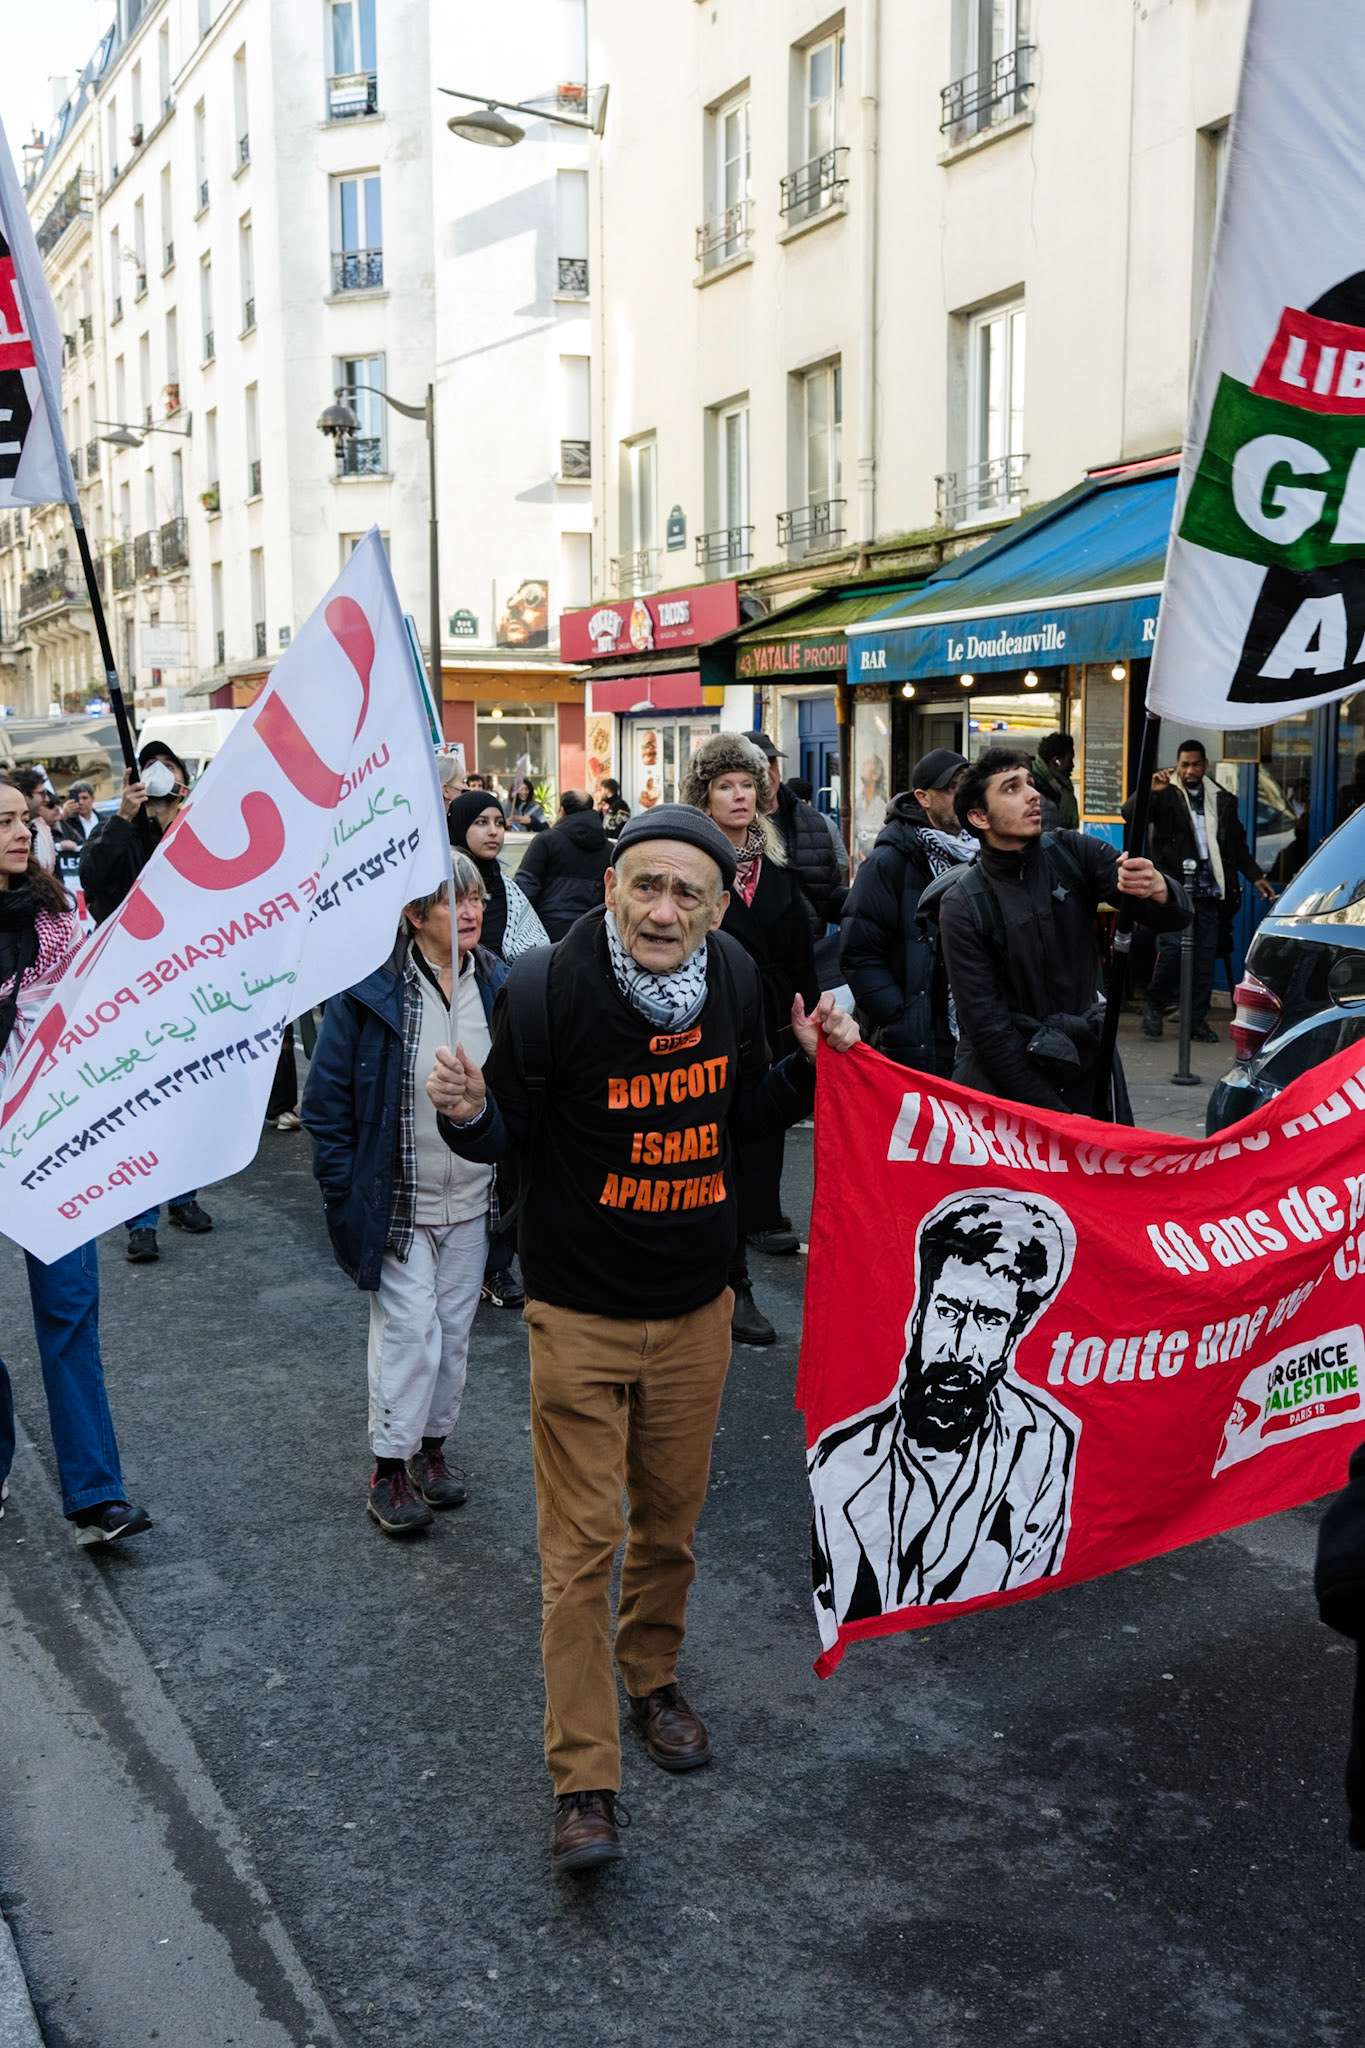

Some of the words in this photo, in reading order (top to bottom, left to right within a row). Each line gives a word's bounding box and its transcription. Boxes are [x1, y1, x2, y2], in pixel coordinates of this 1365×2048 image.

[1231, 433, 1365, 546] G
[753, 643, 801, 672] YATALIE
[860, 649, 887, 670] BAR
[947, 638, 963, 662] Le
[966, 623, 1066, 660] Doudeauville
[1257, 592, 1365, 680] A
[607, 1055, 729, 1110] BOYCOTT
[630, 1122, 719, 1166] ISRAEL
[598, 1169, 727, 1213] APARTHEID
[1146, 1221, 1210, 1276] 40
[1199, 1209, 1289, 1268] ans
[1277, 1185, 1345, 1244] de
[1046, 1329, 1190, 1387] toute
[1194, 1305, 1268, 1369] une
[1267, 1342, 1349, 1393] URGENCE
[1264, 1364, 1359, 1419] PALESTINE
[1289, 1408, 1312, 1425] PARIS
